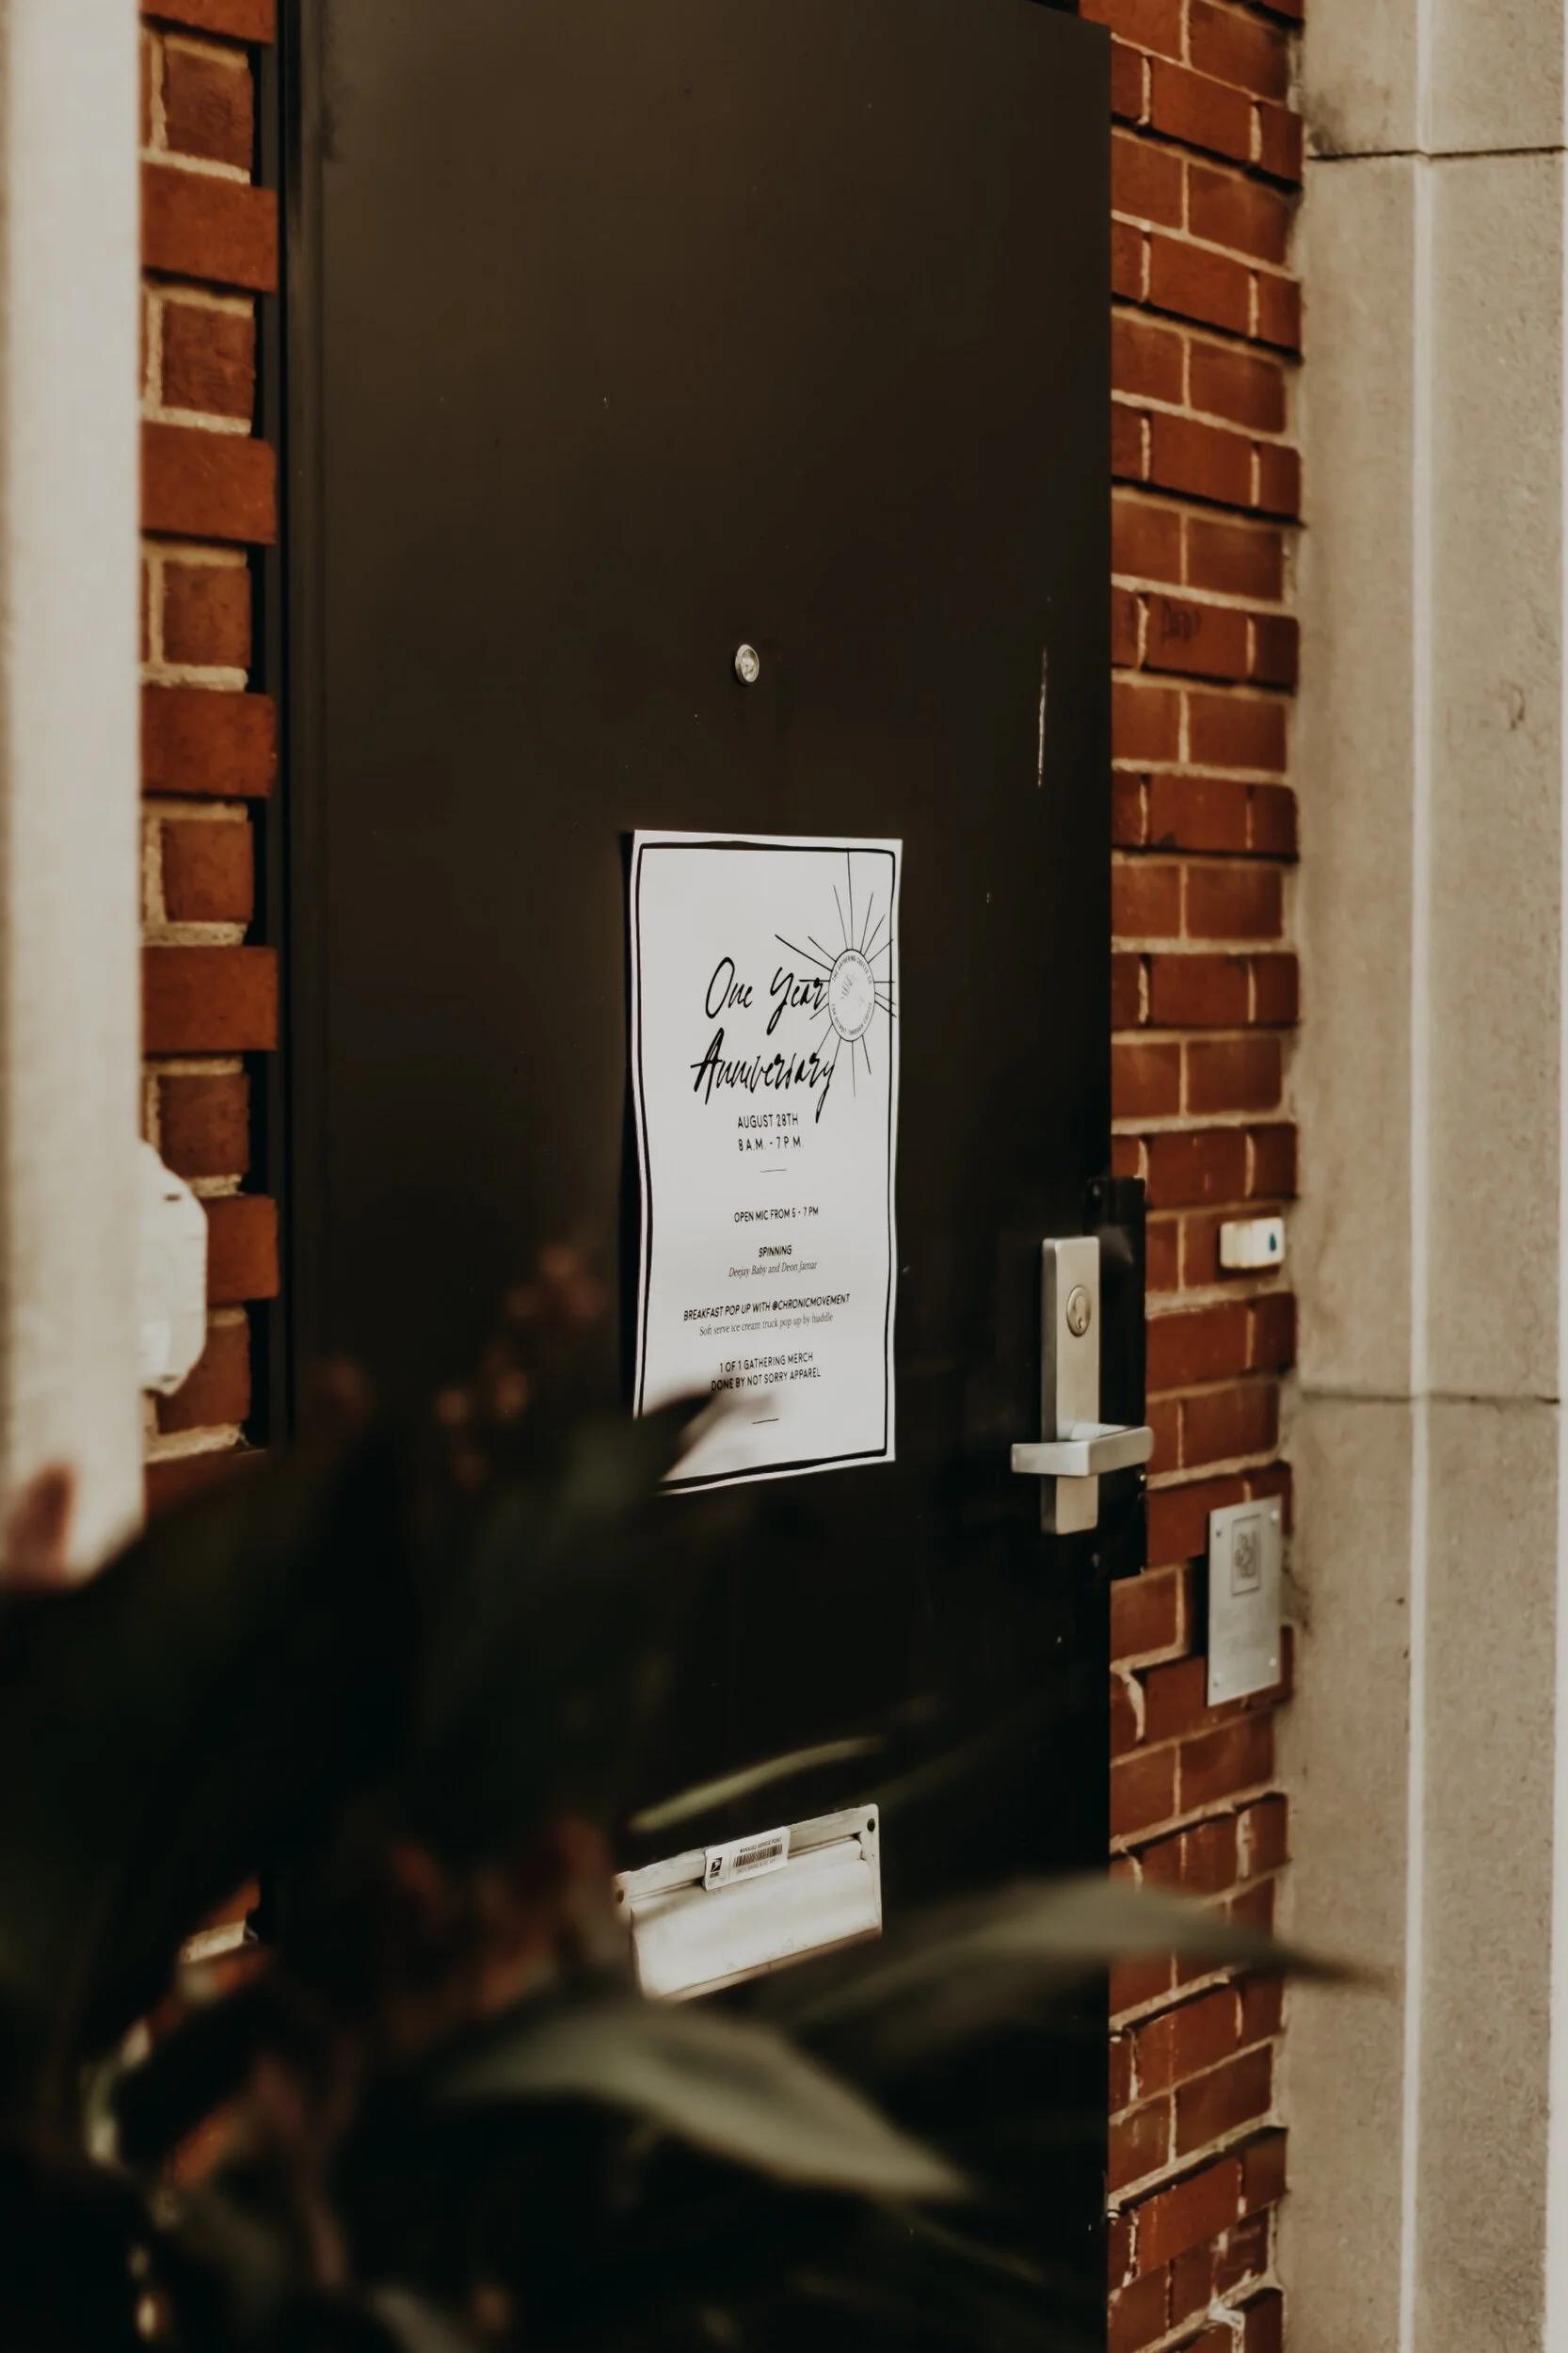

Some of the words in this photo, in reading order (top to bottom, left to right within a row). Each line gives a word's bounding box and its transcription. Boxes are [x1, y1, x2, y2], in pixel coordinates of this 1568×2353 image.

[706, 956, 753, 1019] One
[766, 967, 828, 1035] Year
[690, 1027, 835, 1124] Anniversary
[738, 1113, 773, 1128] AUGUST
[776, 1112, 798, 1127] 28TH
[738, 1138, 744, 1151] 8
[776, 1136, 780, 1148] 7
[734, 1211, 754, 1223] OPEN
[756, 1209, 768, 1221] MIC
[771, 1209, 790, 1220] FROM
[792, 1208, 796, 1218] 5
[803, 1207, 807, 1216] 7
[808, 1206, 819, 1216] PM
[759, 1244, 792, 1257] SPINNING
[728, 1267, 750, 1279] Deejay
[751, 1265, 768, 1276] Baby
[768, 1262, 780, 1273] and
[683, 1305, 724, 1321] BREAKFAST
[725, 1305, 740, 1316] POP
[741, 1304, 751, 1314] UP
[753, 1302, 771, 1313] WITH
[772, 1293, 850, 1311] @CHRONICMOVEMENT
[713, 1324, 730, 1335] serve
[731, 1322, 741, 1333] ice
[742, 1321, 761, 1332] cream
[761, 1318, 778, 1329] truck
[779, 1319, 792, 1329] pop
[793, 1316, 802, 1328] up
[803, 1314, 810, 1326] by
[726, 1360, 736, 1372] OF
[744, 1355, 786, 1370] GATHERING
[788, 1352, 813, 1364] MERCH
[712, 1377, 734, 1391] DONE
[735, 1377, 745, 1388] BY
[747, 1374, 762, 1385] NOT
[764, 1371, 788, 1384] SORRY
[790, 1368, 821, 1380] APPAREL
